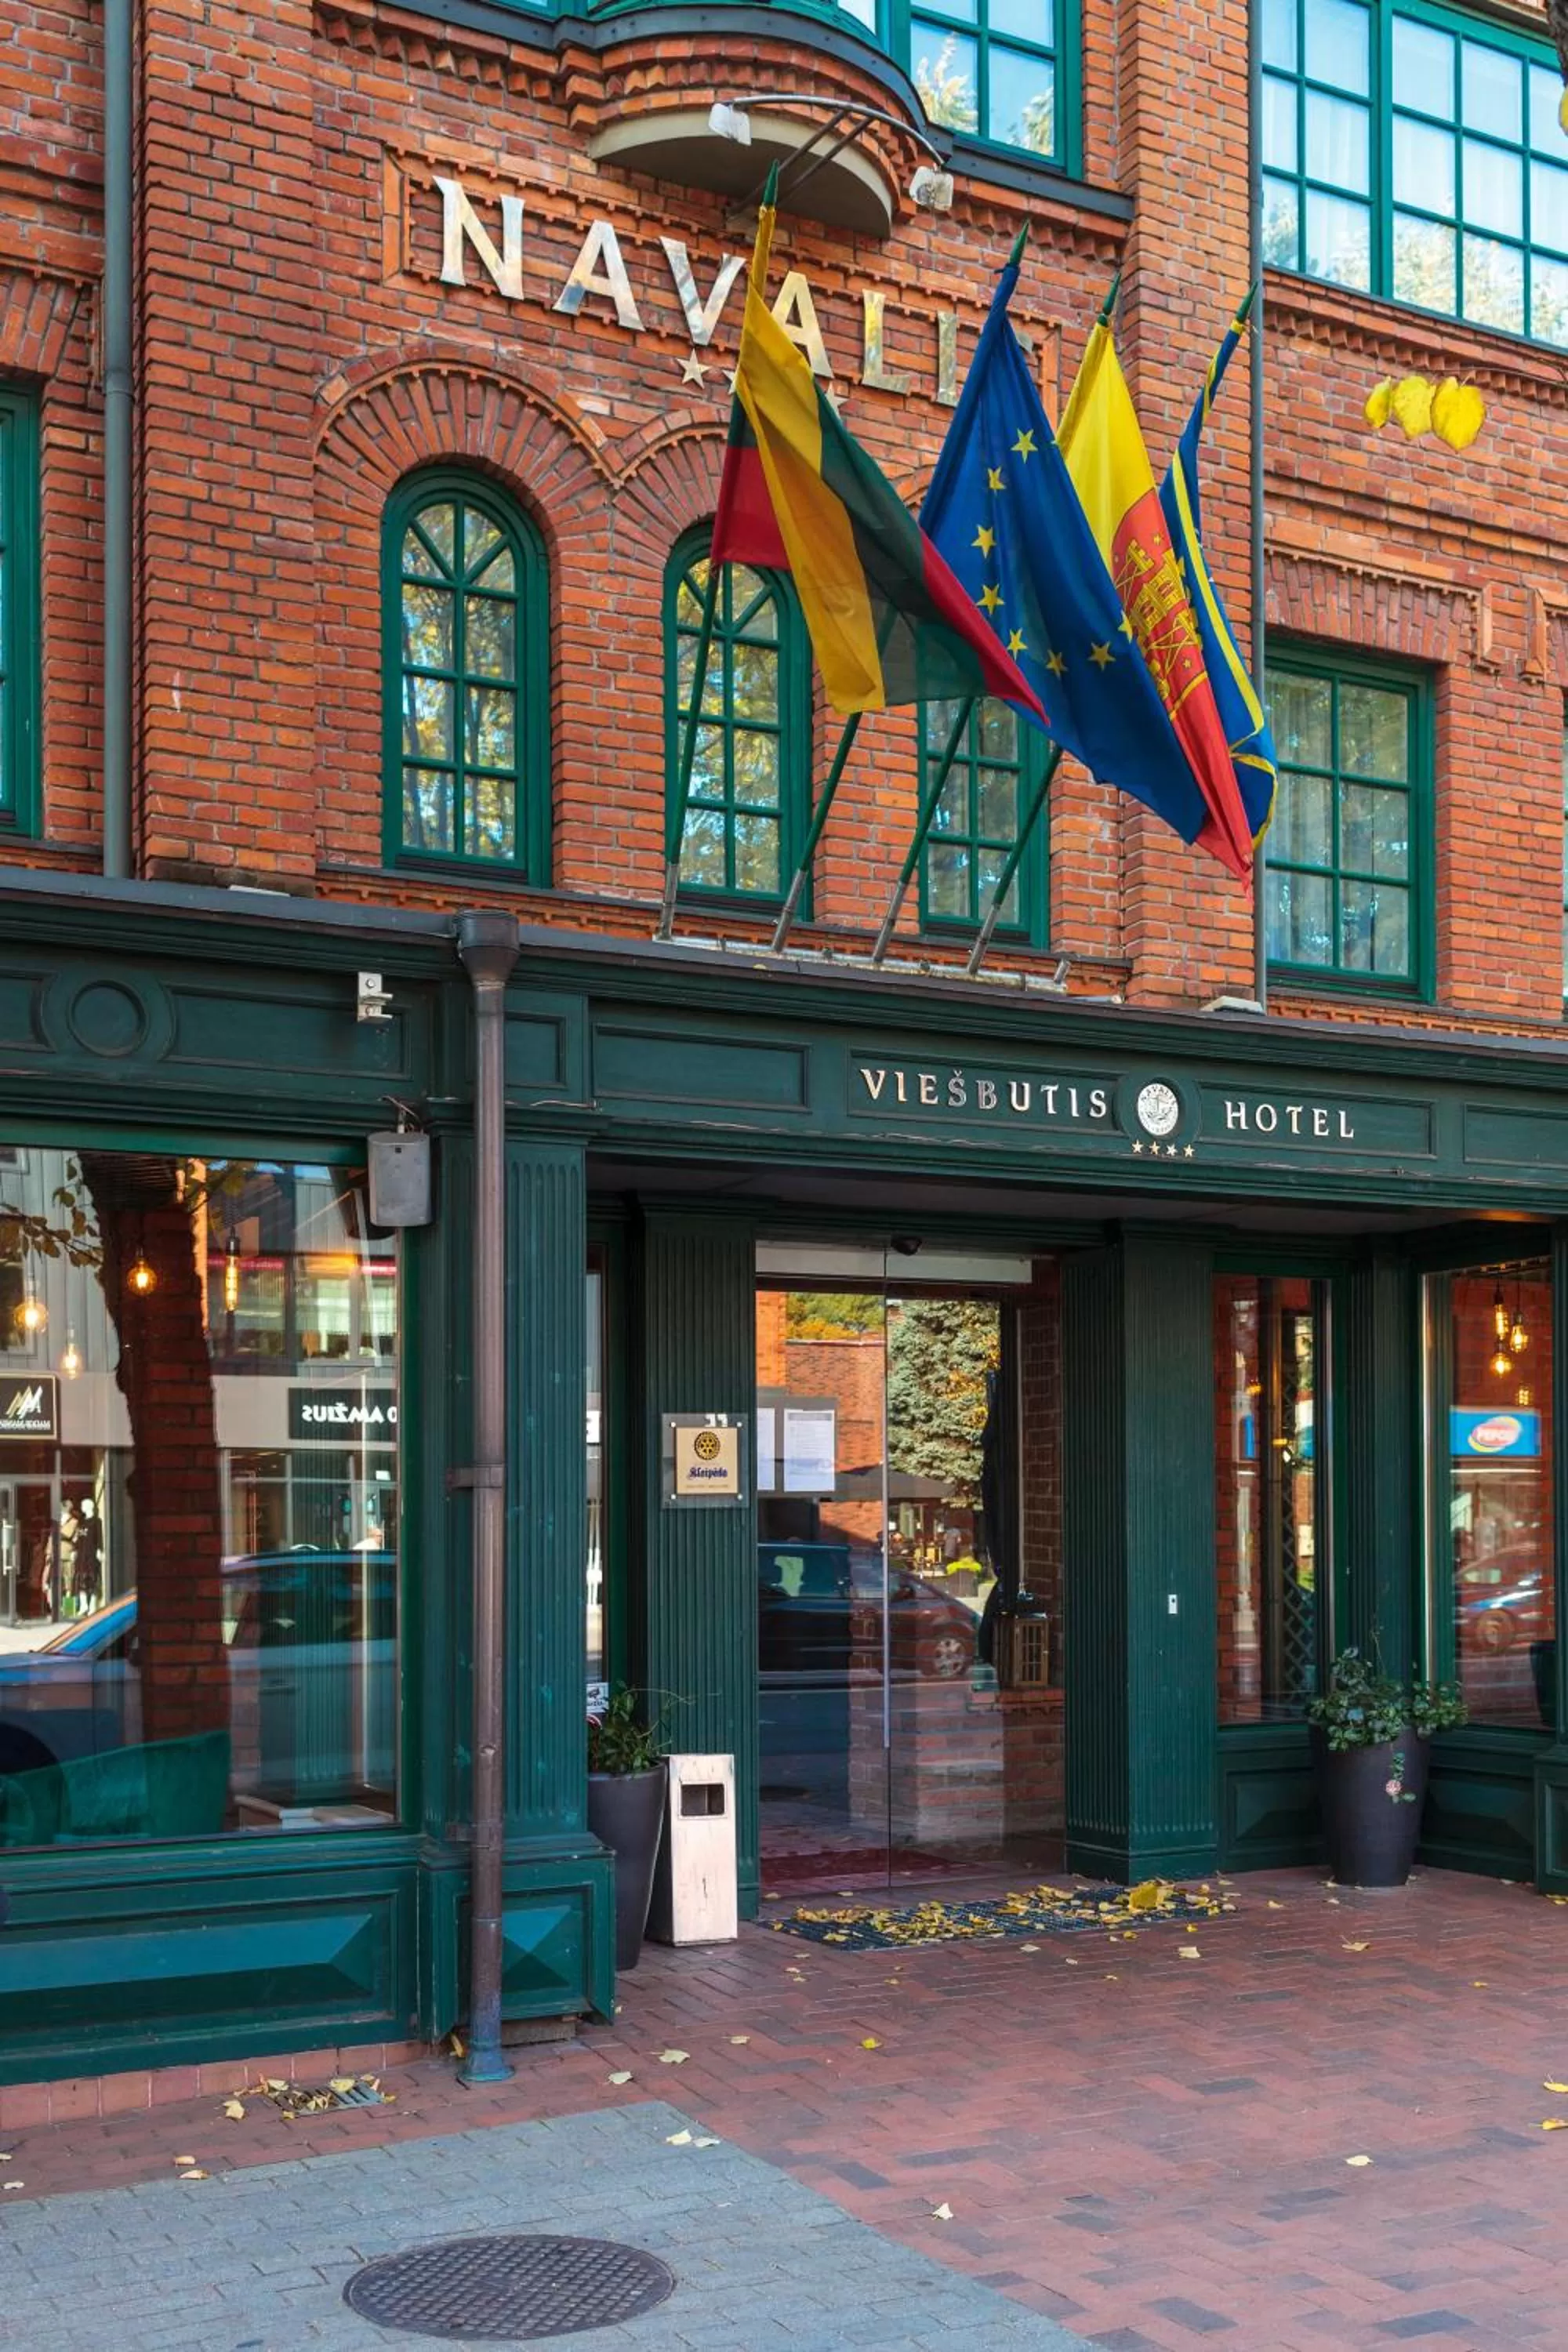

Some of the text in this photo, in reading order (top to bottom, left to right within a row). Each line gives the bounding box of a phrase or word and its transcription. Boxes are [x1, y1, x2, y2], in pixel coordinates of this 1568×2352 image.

[433, 175, 1033, 408] NAVALI
[860, 1069, 1108, 1119] VIEŠBUTIS
[1225, 1101, 1356, 1139] HOTEL
